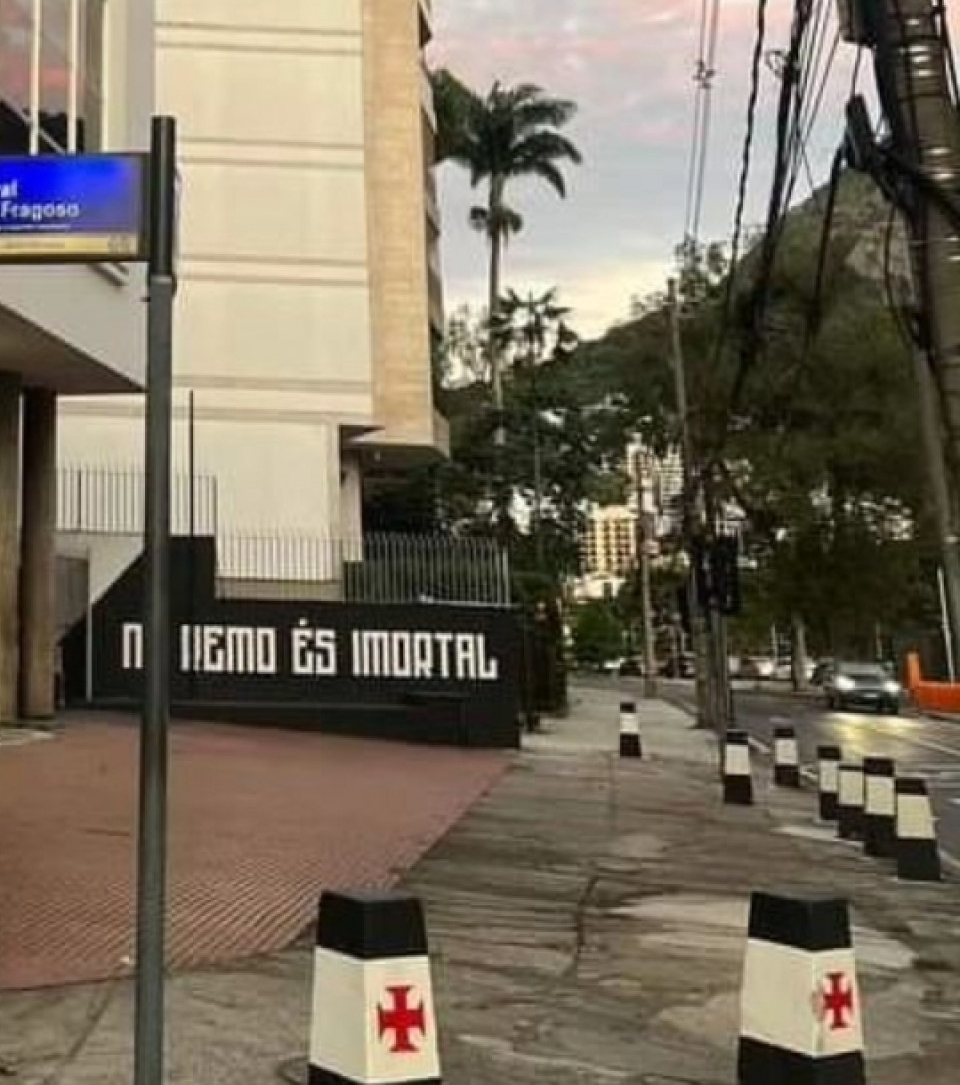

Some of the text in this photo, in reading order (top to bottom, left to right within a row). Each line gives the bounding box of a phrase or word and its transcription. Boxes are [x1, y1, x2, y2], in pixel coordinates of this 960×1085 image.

[0, 201, 81, 222] Fragoso
[291, 617, 337, 675] ÉS
[351, 629, 499, 681] IMORTAL
